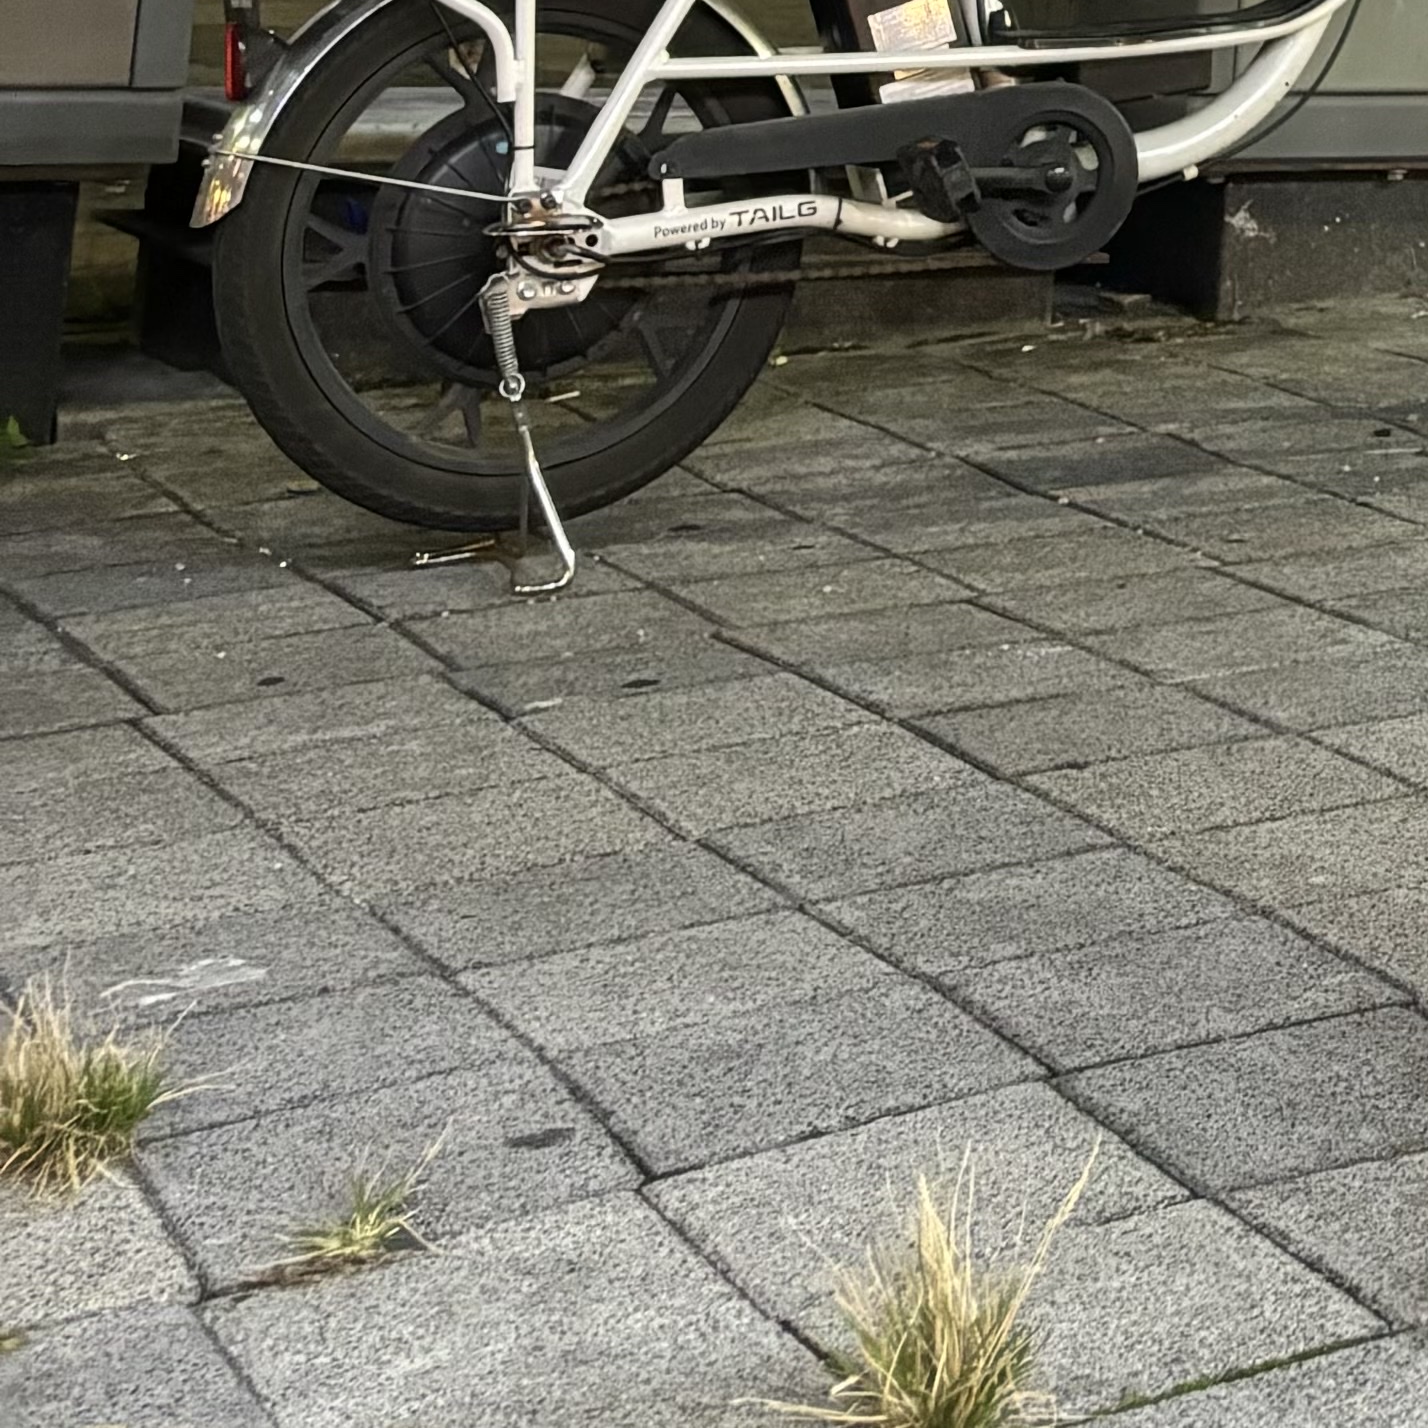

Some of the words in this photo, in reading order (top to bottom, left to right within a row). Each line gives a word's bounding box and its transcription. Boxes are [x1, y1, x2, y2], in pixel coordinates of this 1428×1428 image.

[654, 219, 708, 239] Powered
[711, 217, 727, 231] by
[729, 200, 818, 227] TAILG
